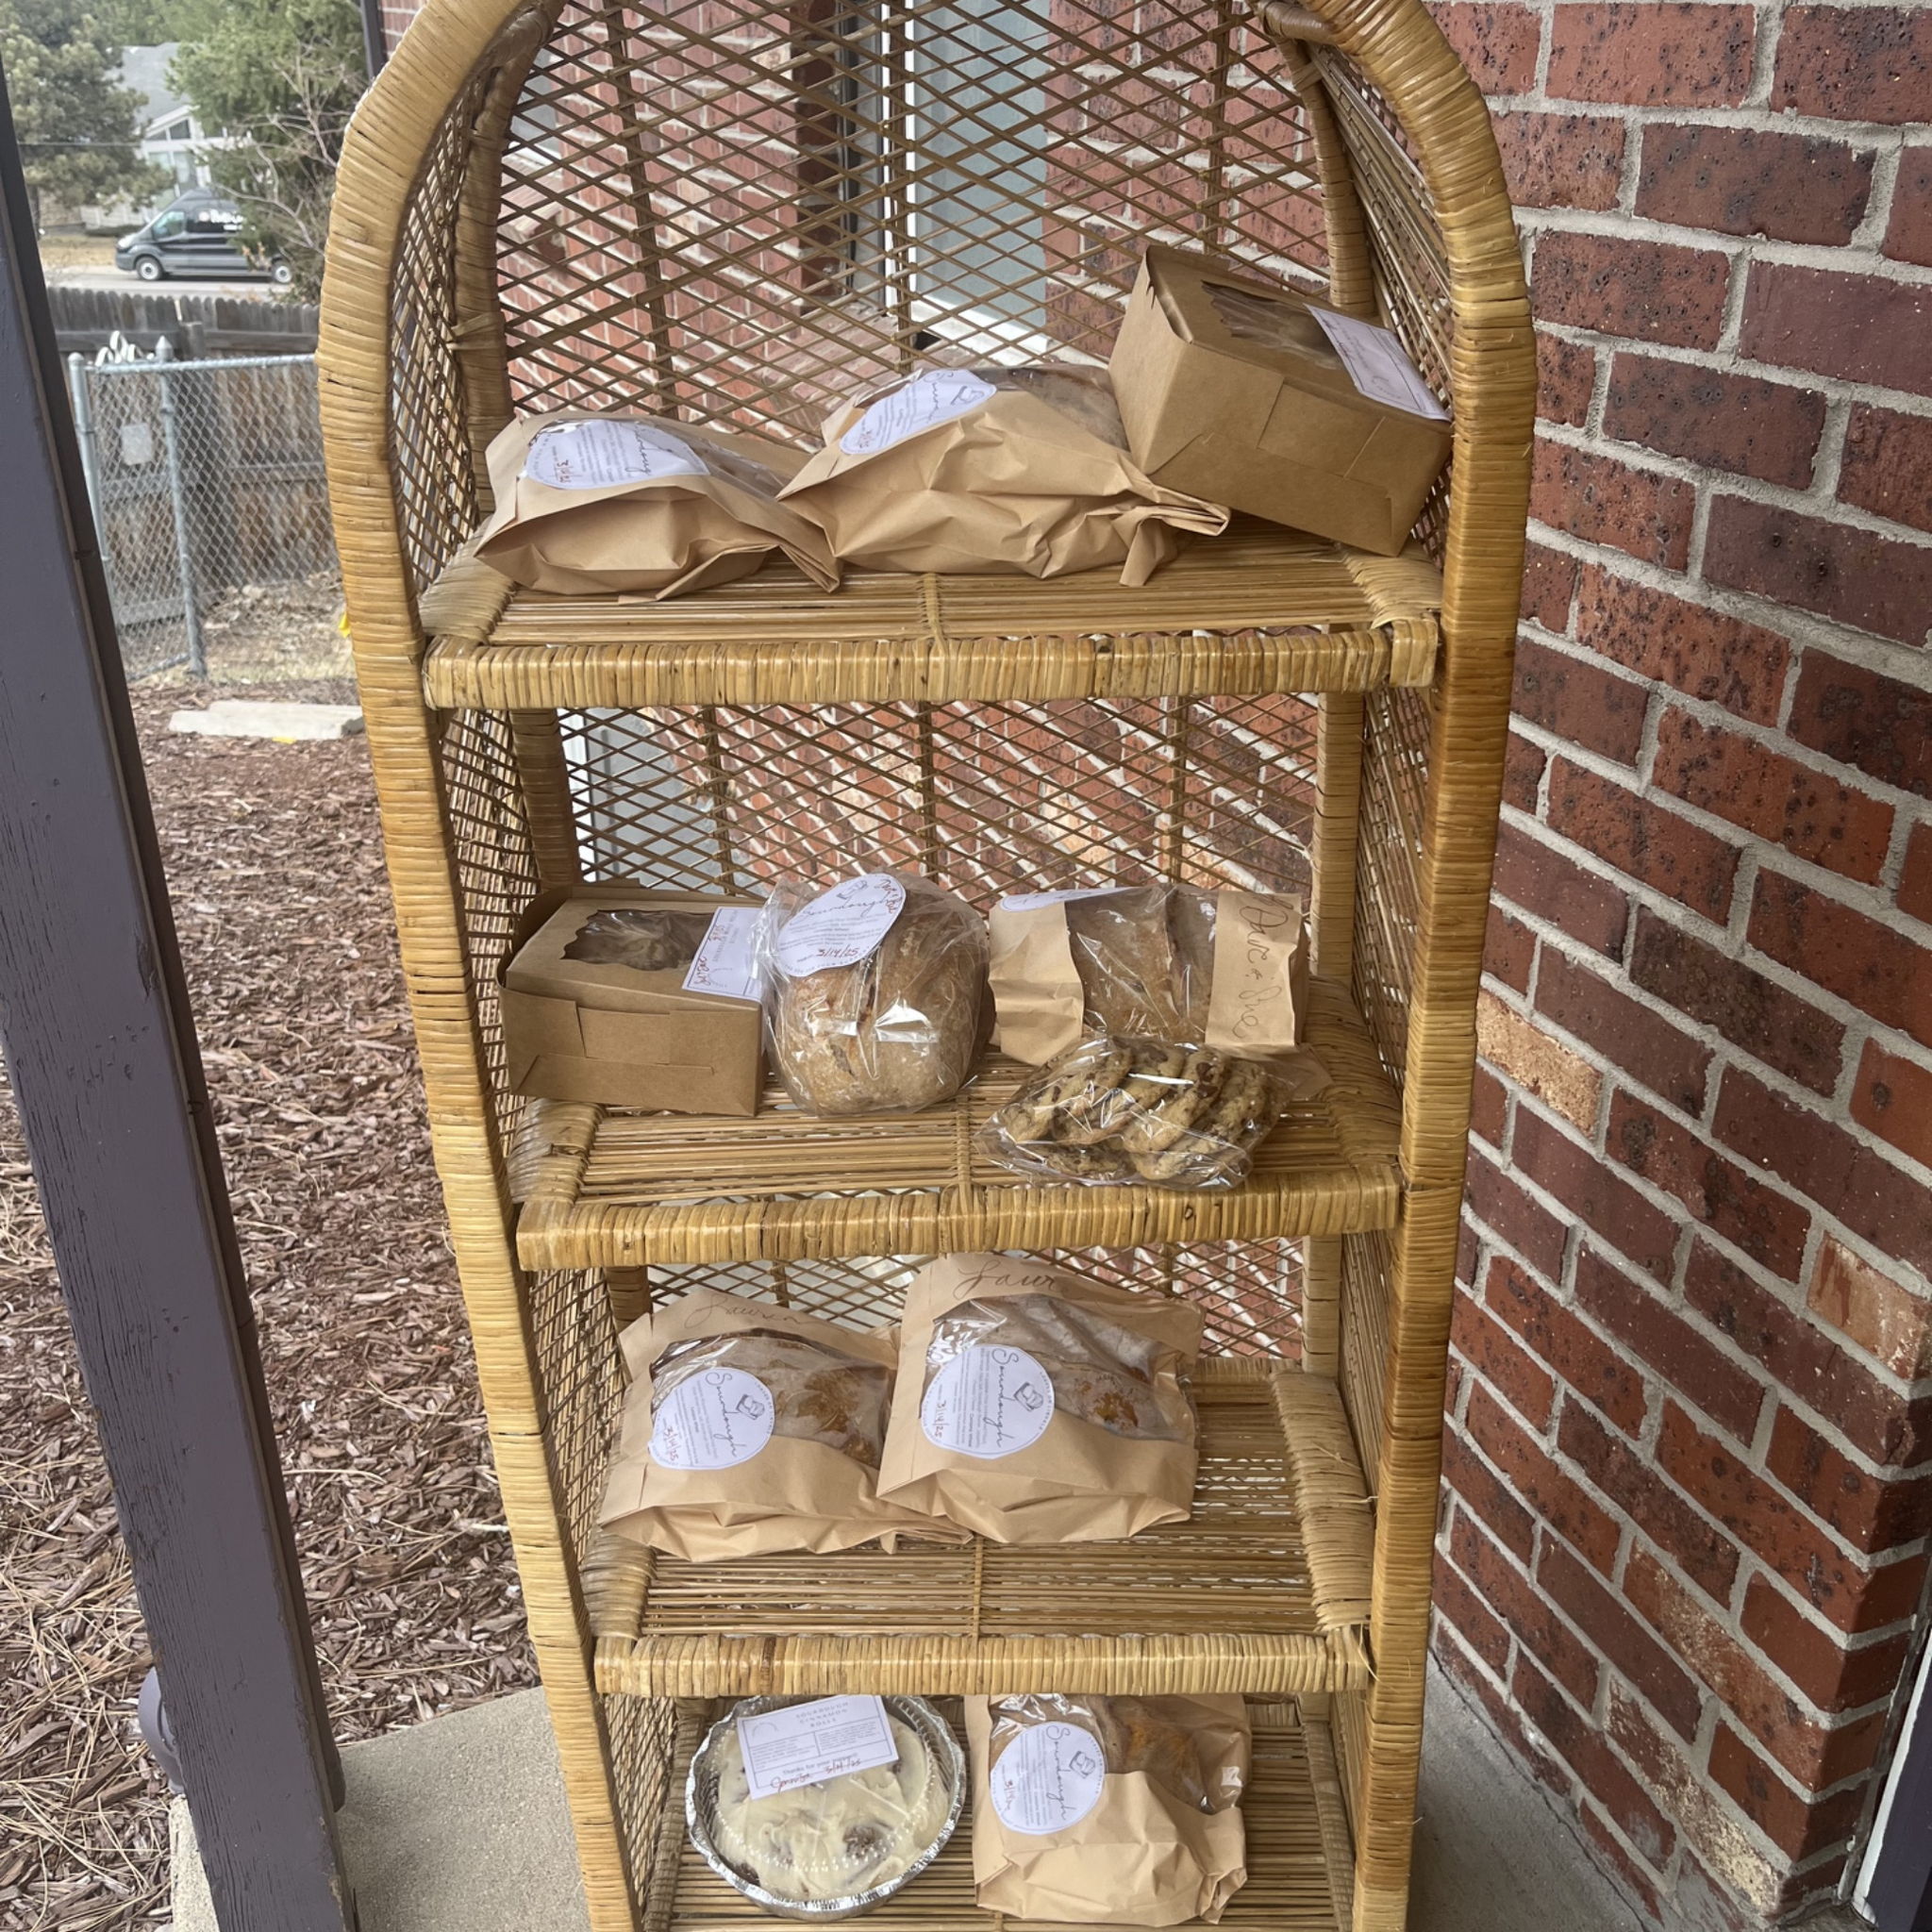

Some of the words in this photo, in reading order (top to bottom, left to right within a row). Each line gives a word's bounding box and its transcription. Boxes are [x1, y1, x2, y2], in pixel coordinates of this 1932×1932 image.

[706, 1372, 745, 1458] Sourdough
[932, 1400, 949, 1438] 3/14/25
[983, 1348, 1019, 1448] Sourdough
[663, 1425, 679, 1462] 3/14/25
[1046, 1725, 1076, 1822] Sourdough
